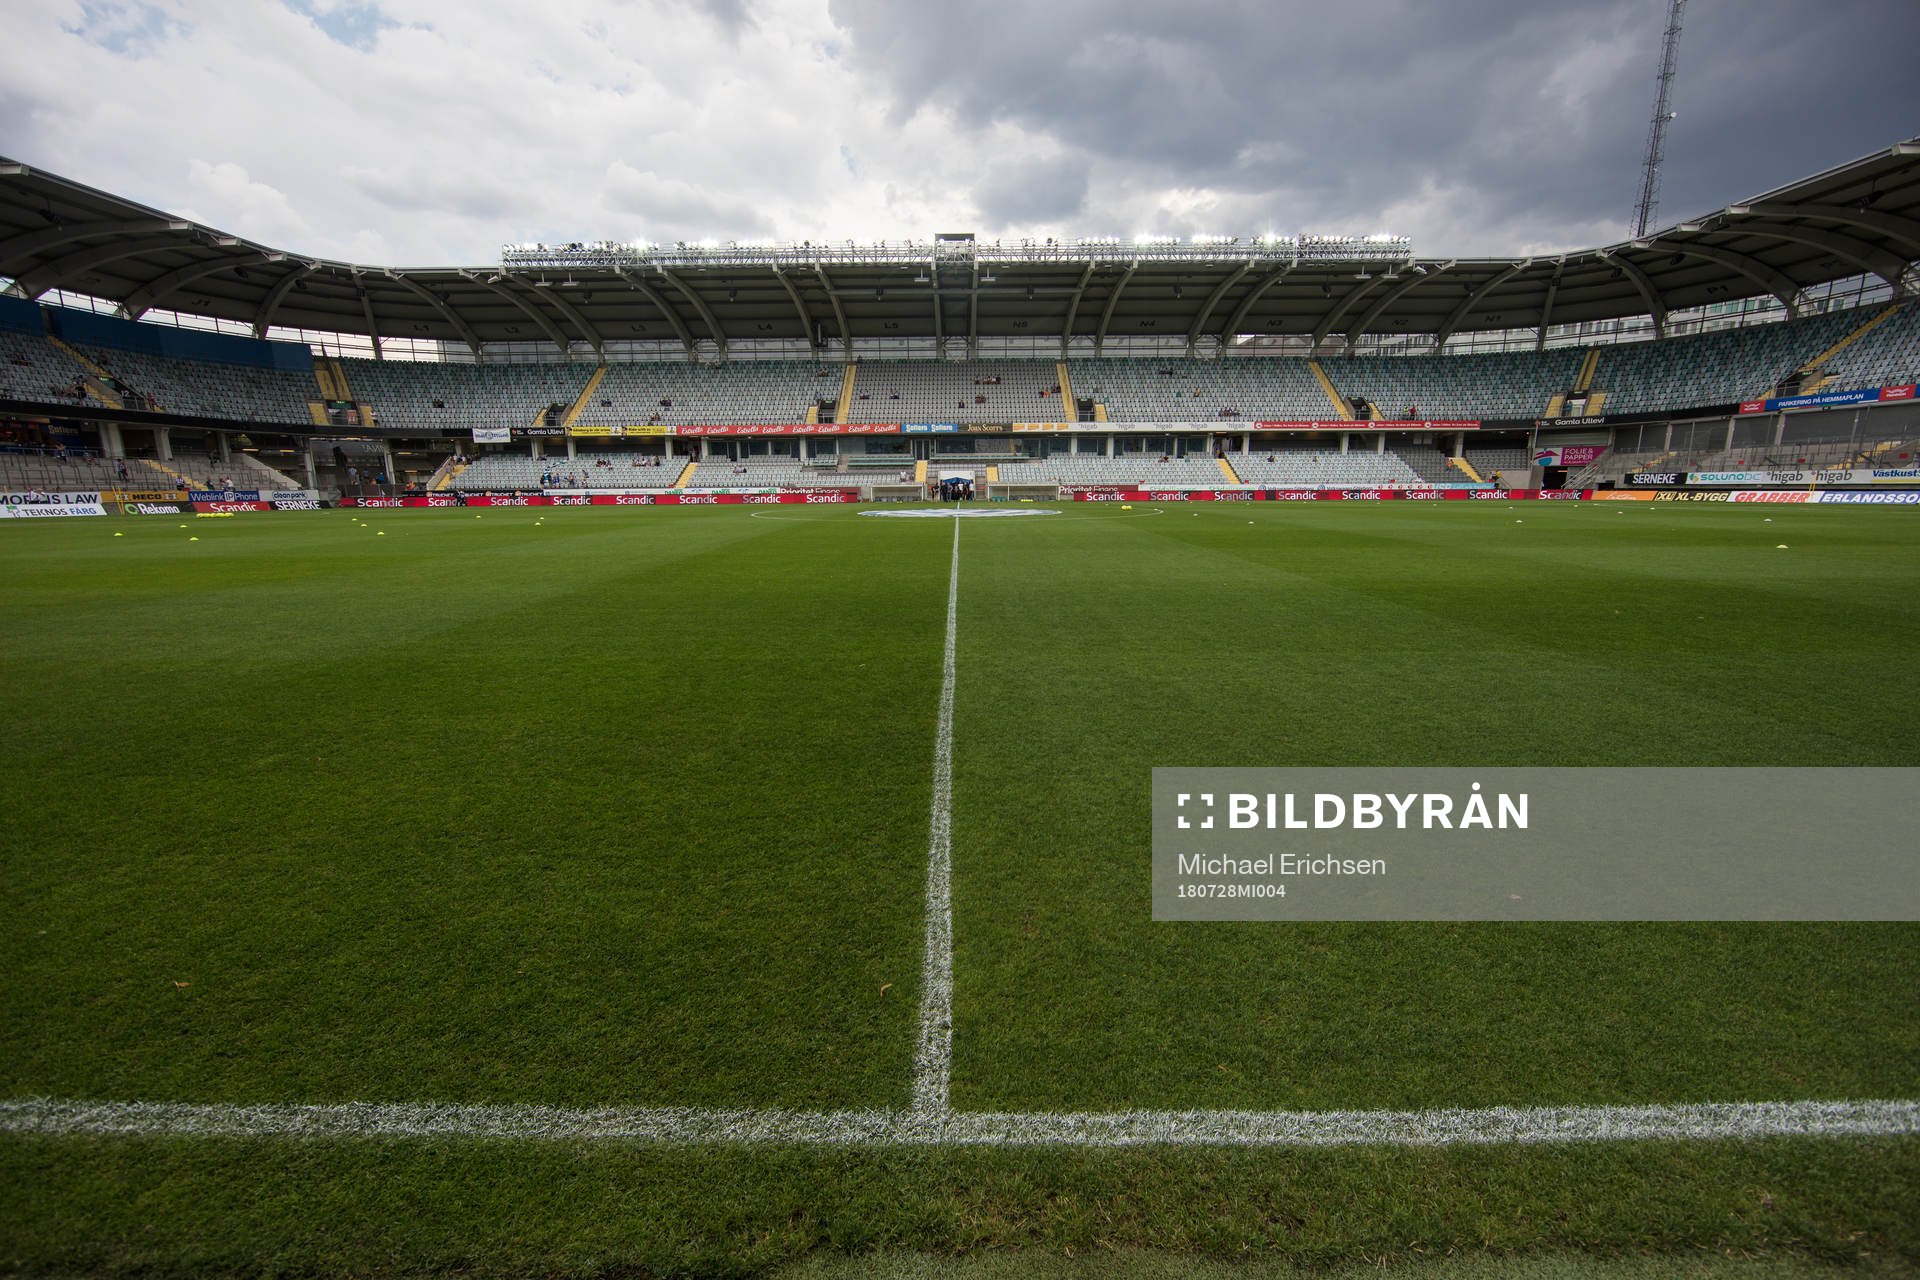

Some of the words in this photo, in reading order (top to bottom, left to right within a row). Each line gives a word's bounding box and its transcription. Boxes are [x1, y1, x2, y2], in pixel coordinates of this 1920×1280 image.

[1778, 398, 1811, 407] PARKERING
[1812, 396, 1822, 404] PÅ
[1822, 393, 1864, 402] HEMMAPLAN
[1555, 418, 1580, 426] Gamla
[1581, 416, 1605, 425] Ullevi
[682, 427, 703, 435] Estrella
[707, 426, 729, 434] Estrella
[737, 426, 759, 434] Estrella
[763, 426, 784, 434] Estrella
[818, 425, 840, 433] Estrella
[848, 425, 870, 433] Estrella
[874, 425, 896, 433] Estrella
[1632, 473, 1677, 484] SERNEKE
[65, 494, 98, 504] LAW
[190, 491, 224, 501] Weblink
[235, 492, 259, 501] Phone
[743, 494, 780, 503] Scandic
[806, 494, 845, 503] Scandic
[1086, 491, 1125, 501] Scandic
[1151, 491, 1189, 501] Scandic
[1214, 491, 1253, 500] Scandic
[1278, 491, 1317, 500] Scandic
[1342, 490, 1380, 500] Scandic
[1406, 490, 1444, 499] Scandic
[1470, 490, 1508, 499] Scandic
[1540, 490, 1581, 500] Scandic
[1675, 492, 1729, 501] XL-BYGG
[1734, 492, 1810, 502] GRABBER
[357, 498, 403, 508] Scandic
[428, 497, 460, 507] Scand
[491, 497, 528, 505] Scandic
[554, 496, 591, 505] Scandic
[616, 495, 654, 504] Scandic
[680, 495, 718, 504] Scandic
[137, 503, 180, 515] Rekomo
[210, 503, 258, 513] Scandic
[275, 501, 321, 511] SERNEKE
[20, 508, 69, 516] TEKNOS
[70, 506, 97, 515] FÄRG
